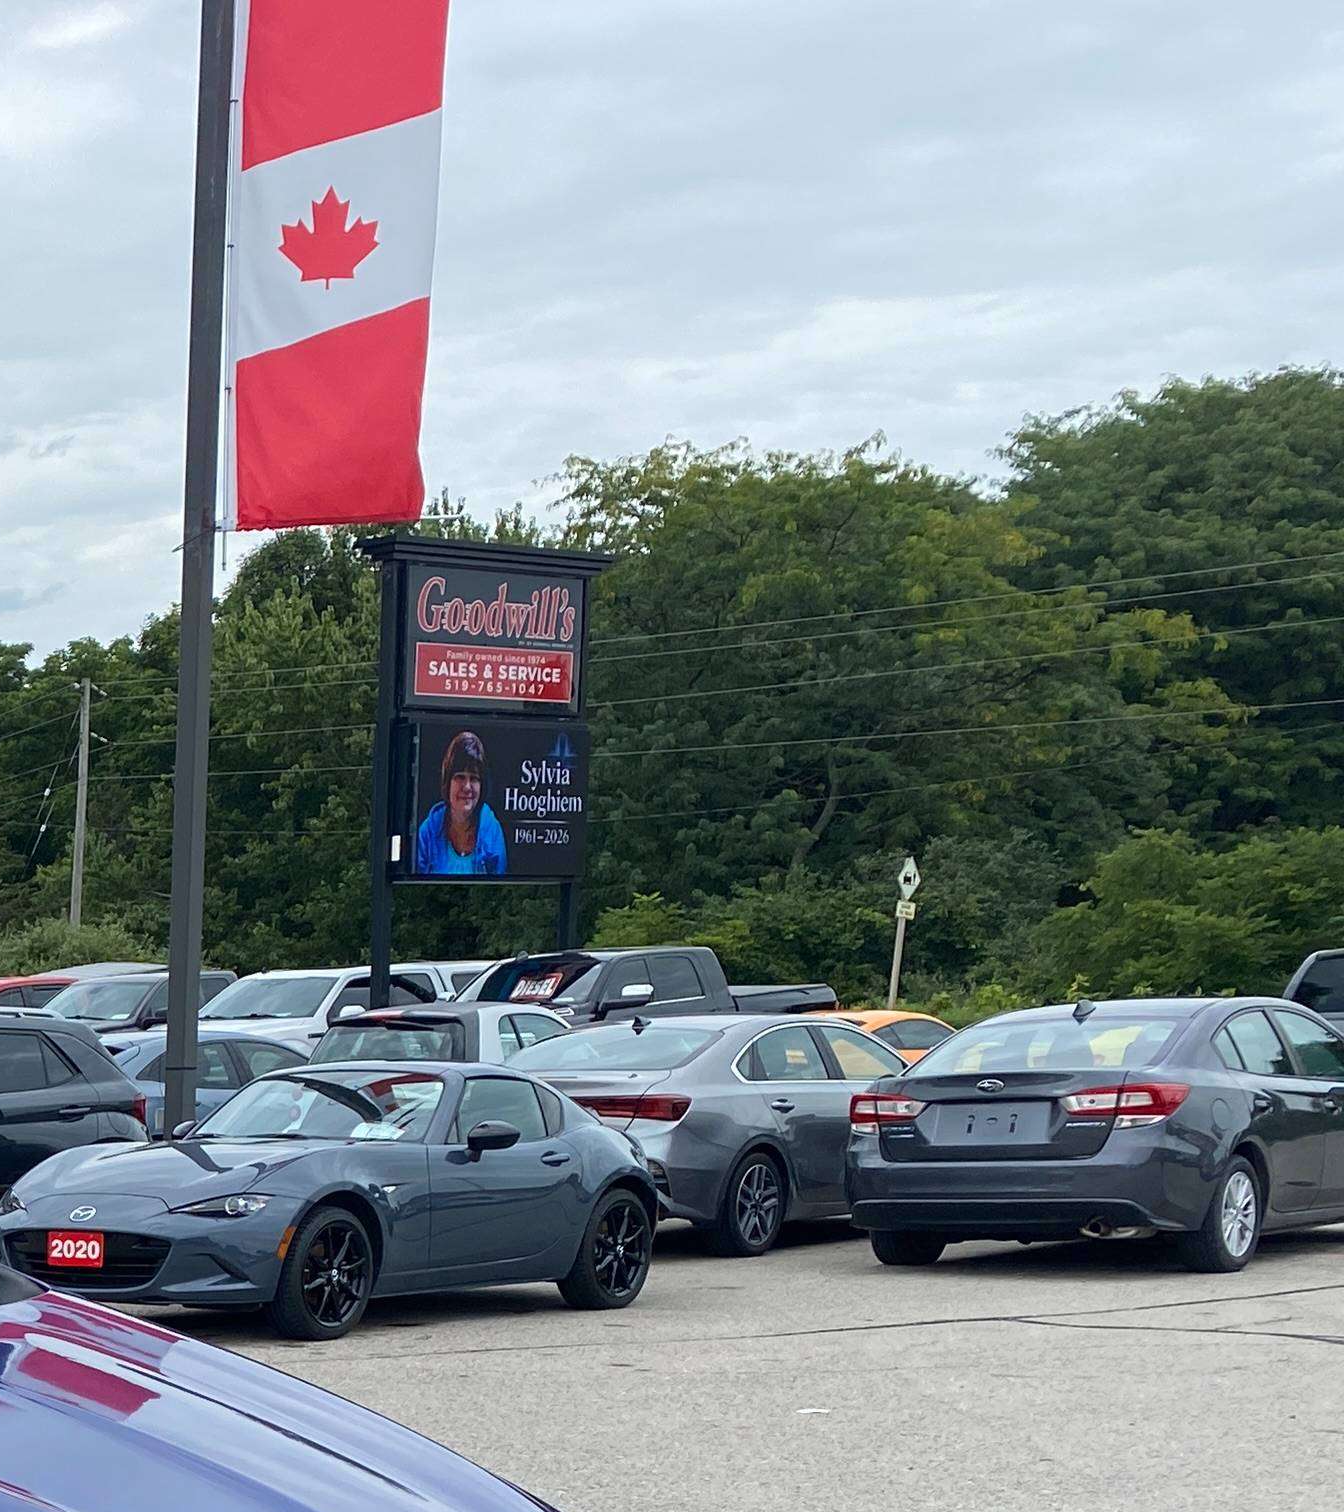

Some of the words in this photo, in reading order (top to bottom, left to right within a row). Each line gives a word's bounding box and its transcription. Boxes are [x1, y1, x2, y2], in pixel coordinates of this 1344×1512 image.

[417, 576, 576, 642] Goodwill's
[446, 650, 473, 662] Family
[475, 653, 502, 663] owned
[504, 654, 526, 664] since
[428, 661, 478, 678] SALES
[483, 664, 493, 679] &
[498, 665, 561, 683] SERVICE
[444, 679, 545, 696] 519-765-1047
[521, 760, 571, 791] Sylvia
[505, 788, 583, 817] Hooghiem
[510, 977, 557, 999] DIESEL
[50, 1239, 100, 1259] 2020
